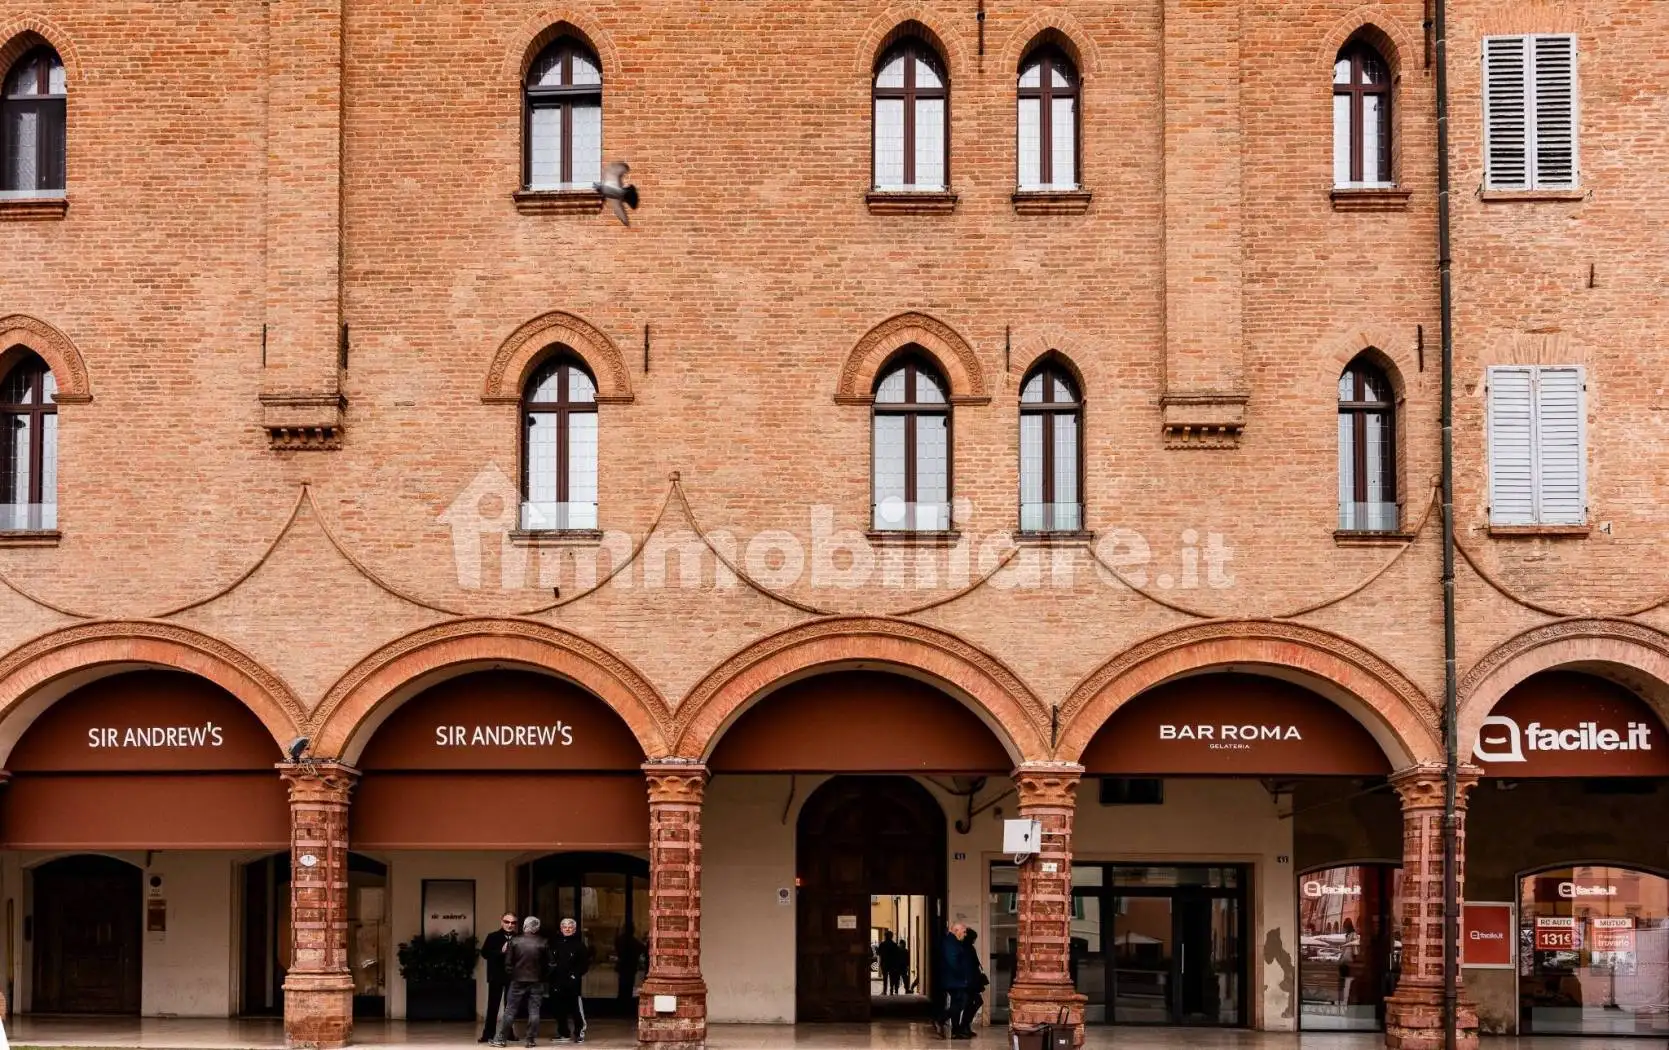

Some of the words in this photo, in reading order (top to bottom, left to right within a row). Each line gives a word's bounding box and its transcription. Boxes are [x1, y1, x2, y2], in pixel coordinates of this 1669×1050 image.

[88, 727, 119, 748] SIR
[123, 721, 223, 748] ANDREW'S
[436, 725, 467, 746] SIR
[471, 720, 573, 746] ANDREW'S
[1159, 724, 1215, 740] BAR
[1220, 724, 1302, 740] ROMA
[1525, 721, 1652, 751] facile.it
